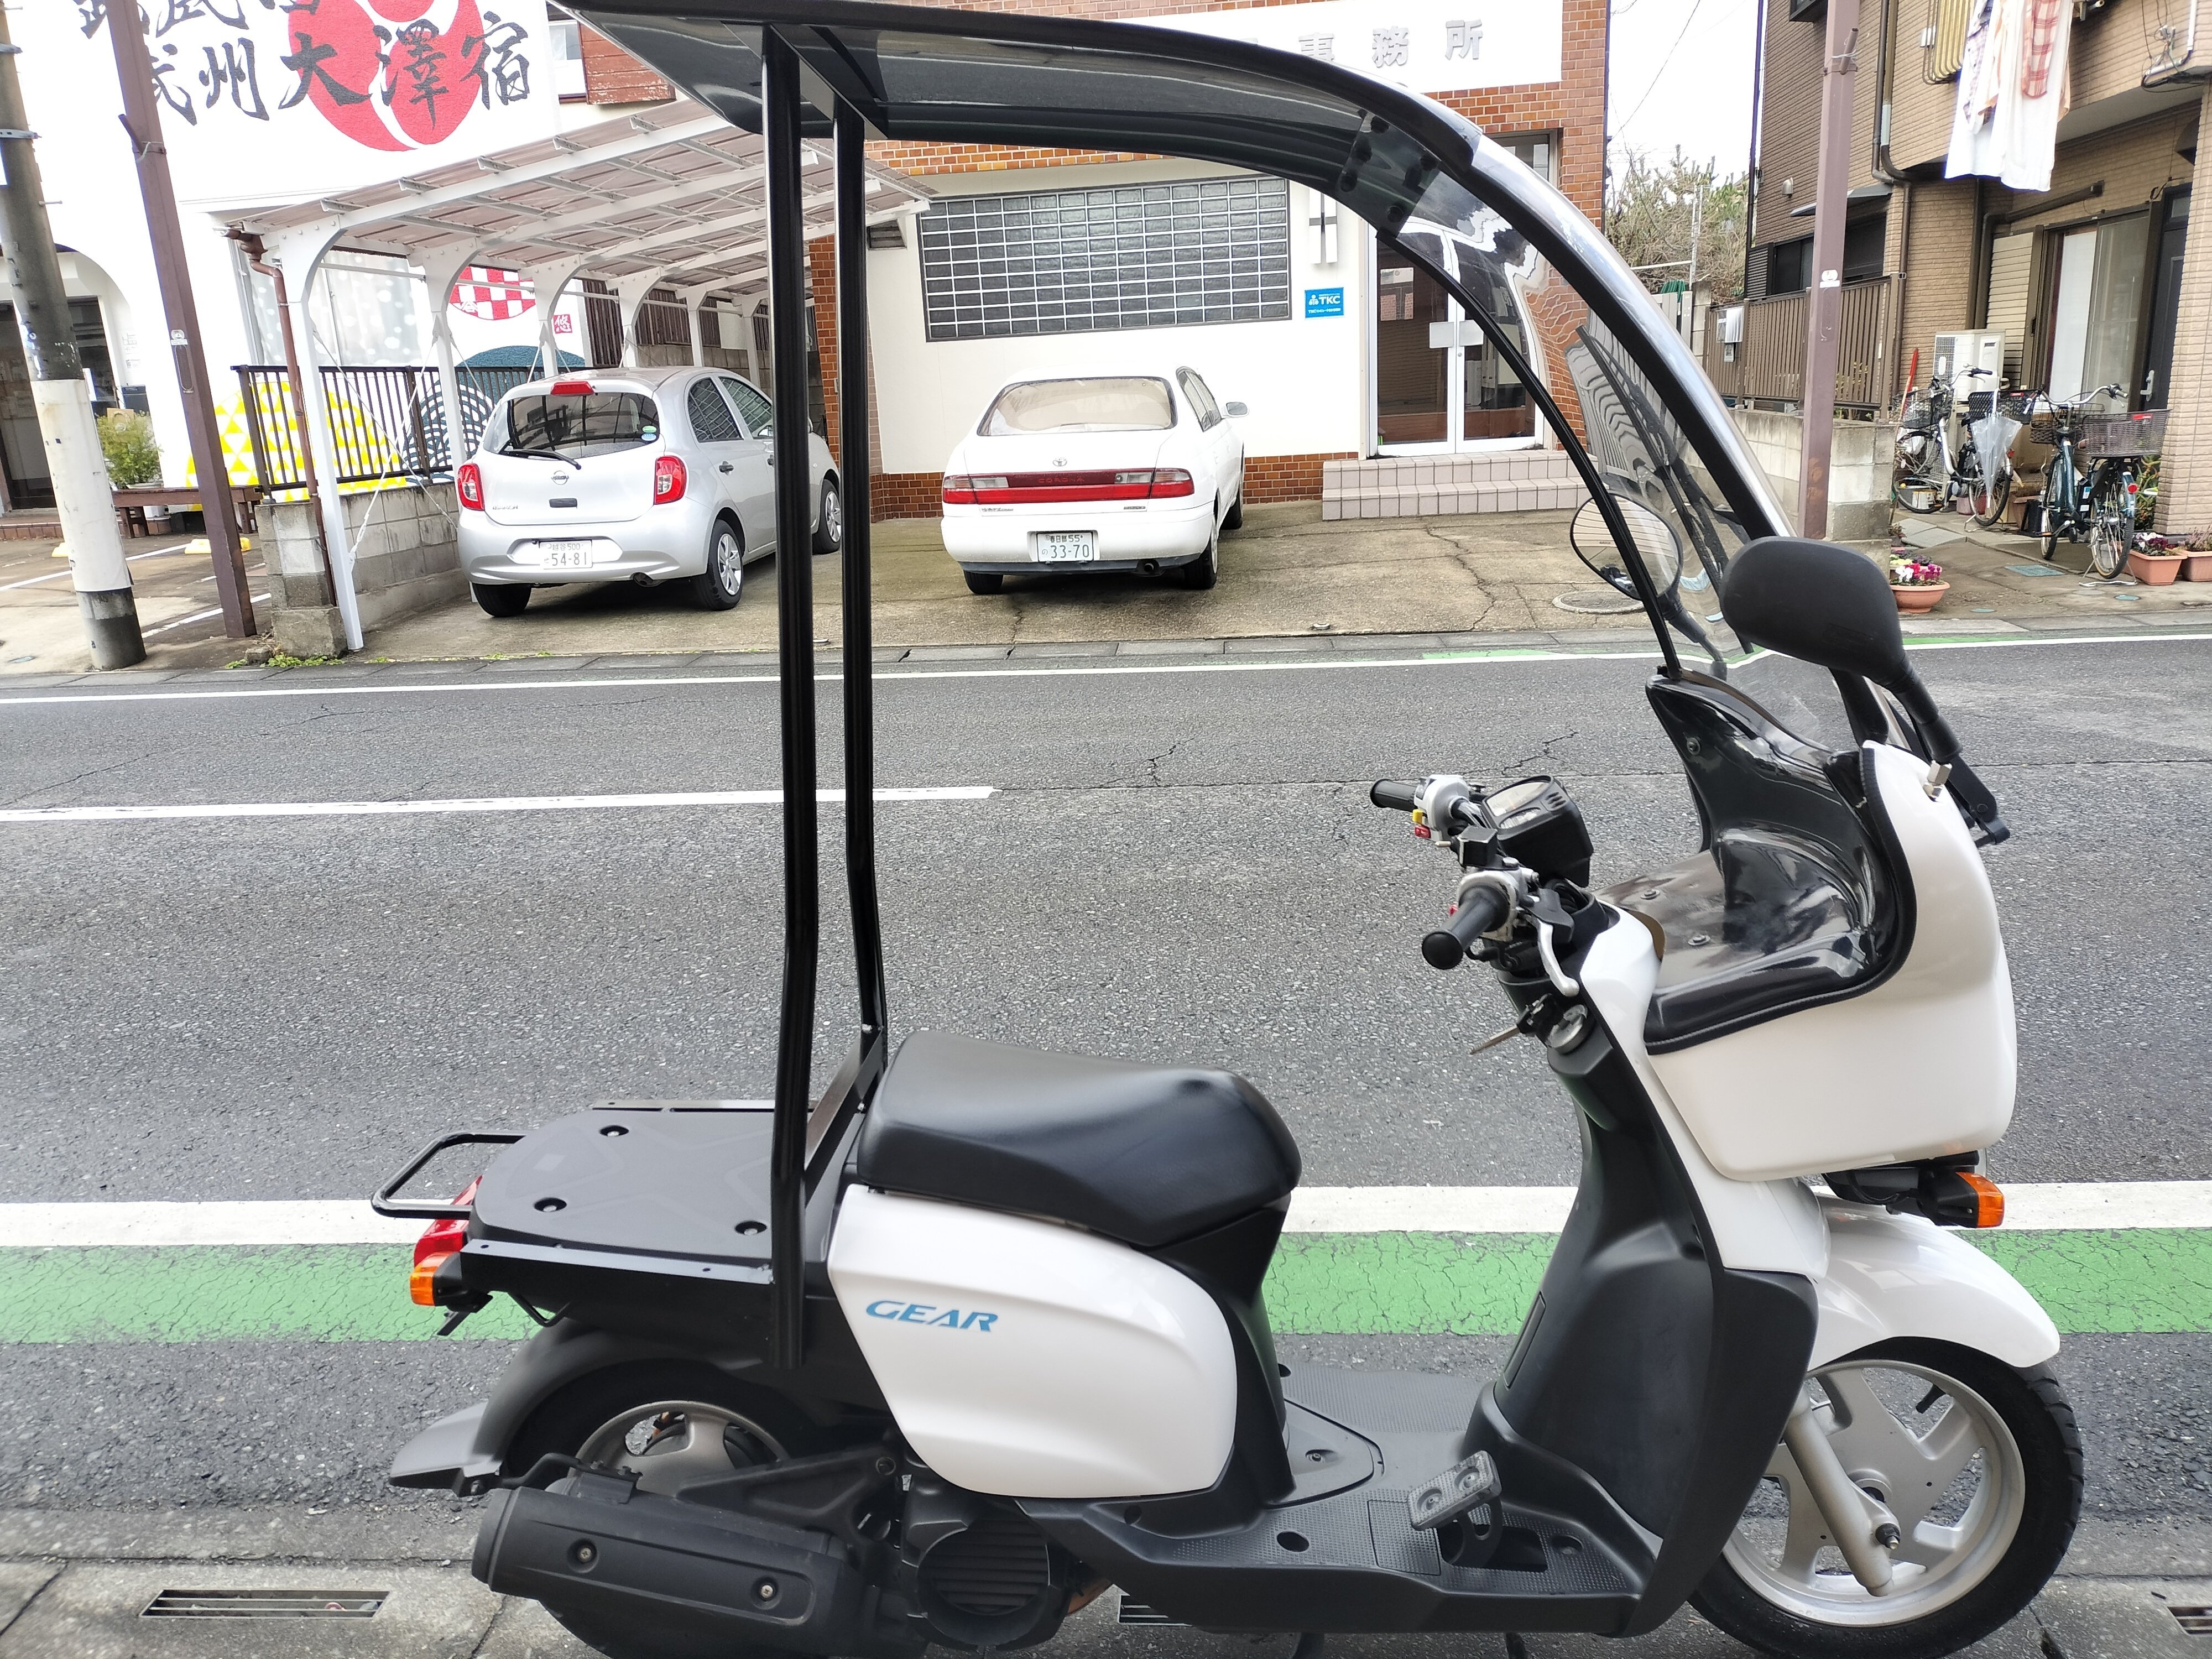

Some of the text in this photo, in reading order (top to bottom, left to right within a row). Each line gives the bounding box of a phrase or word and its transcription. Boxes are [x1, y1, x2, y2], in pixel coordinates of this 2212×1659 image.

[1318, 295, 1340, 305] TKC
[1050, 544, 1089, 559] 33-70
[551, 552, 587, 566] 54-81
[866, 1300, 998, 1332] GEAR
